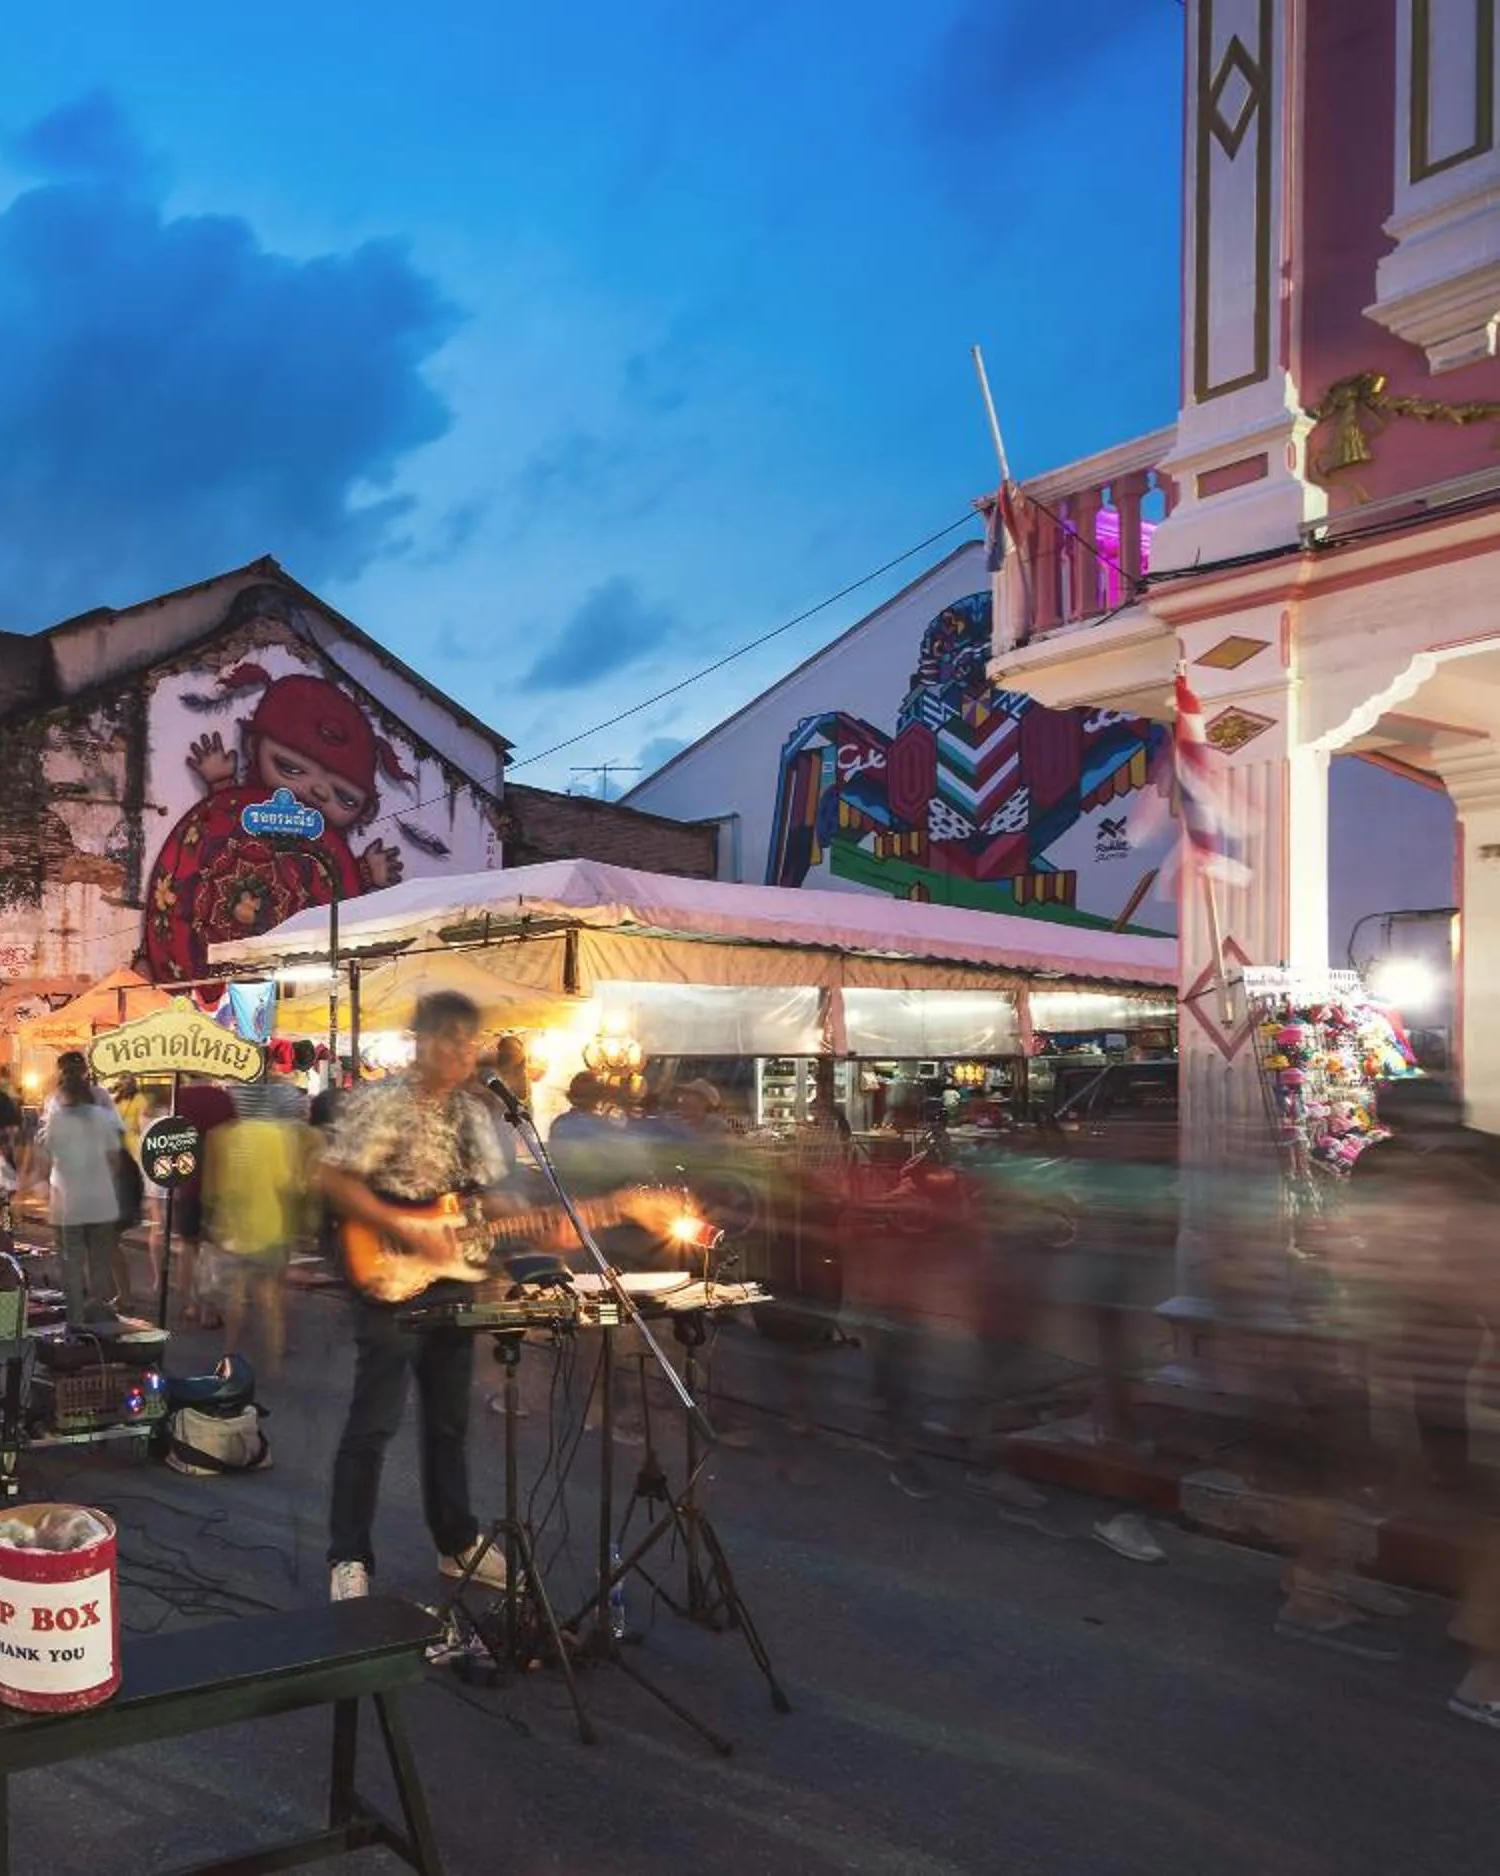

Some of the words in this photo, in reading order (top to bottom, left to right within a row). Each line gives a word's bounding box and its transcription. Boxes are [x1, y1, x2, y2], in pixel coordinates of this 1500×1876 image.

[146, 1135, 168, 1151] NO
[31, 1599, 101, 1631] BOX
[48, 1647, 86, 1662] YOU
